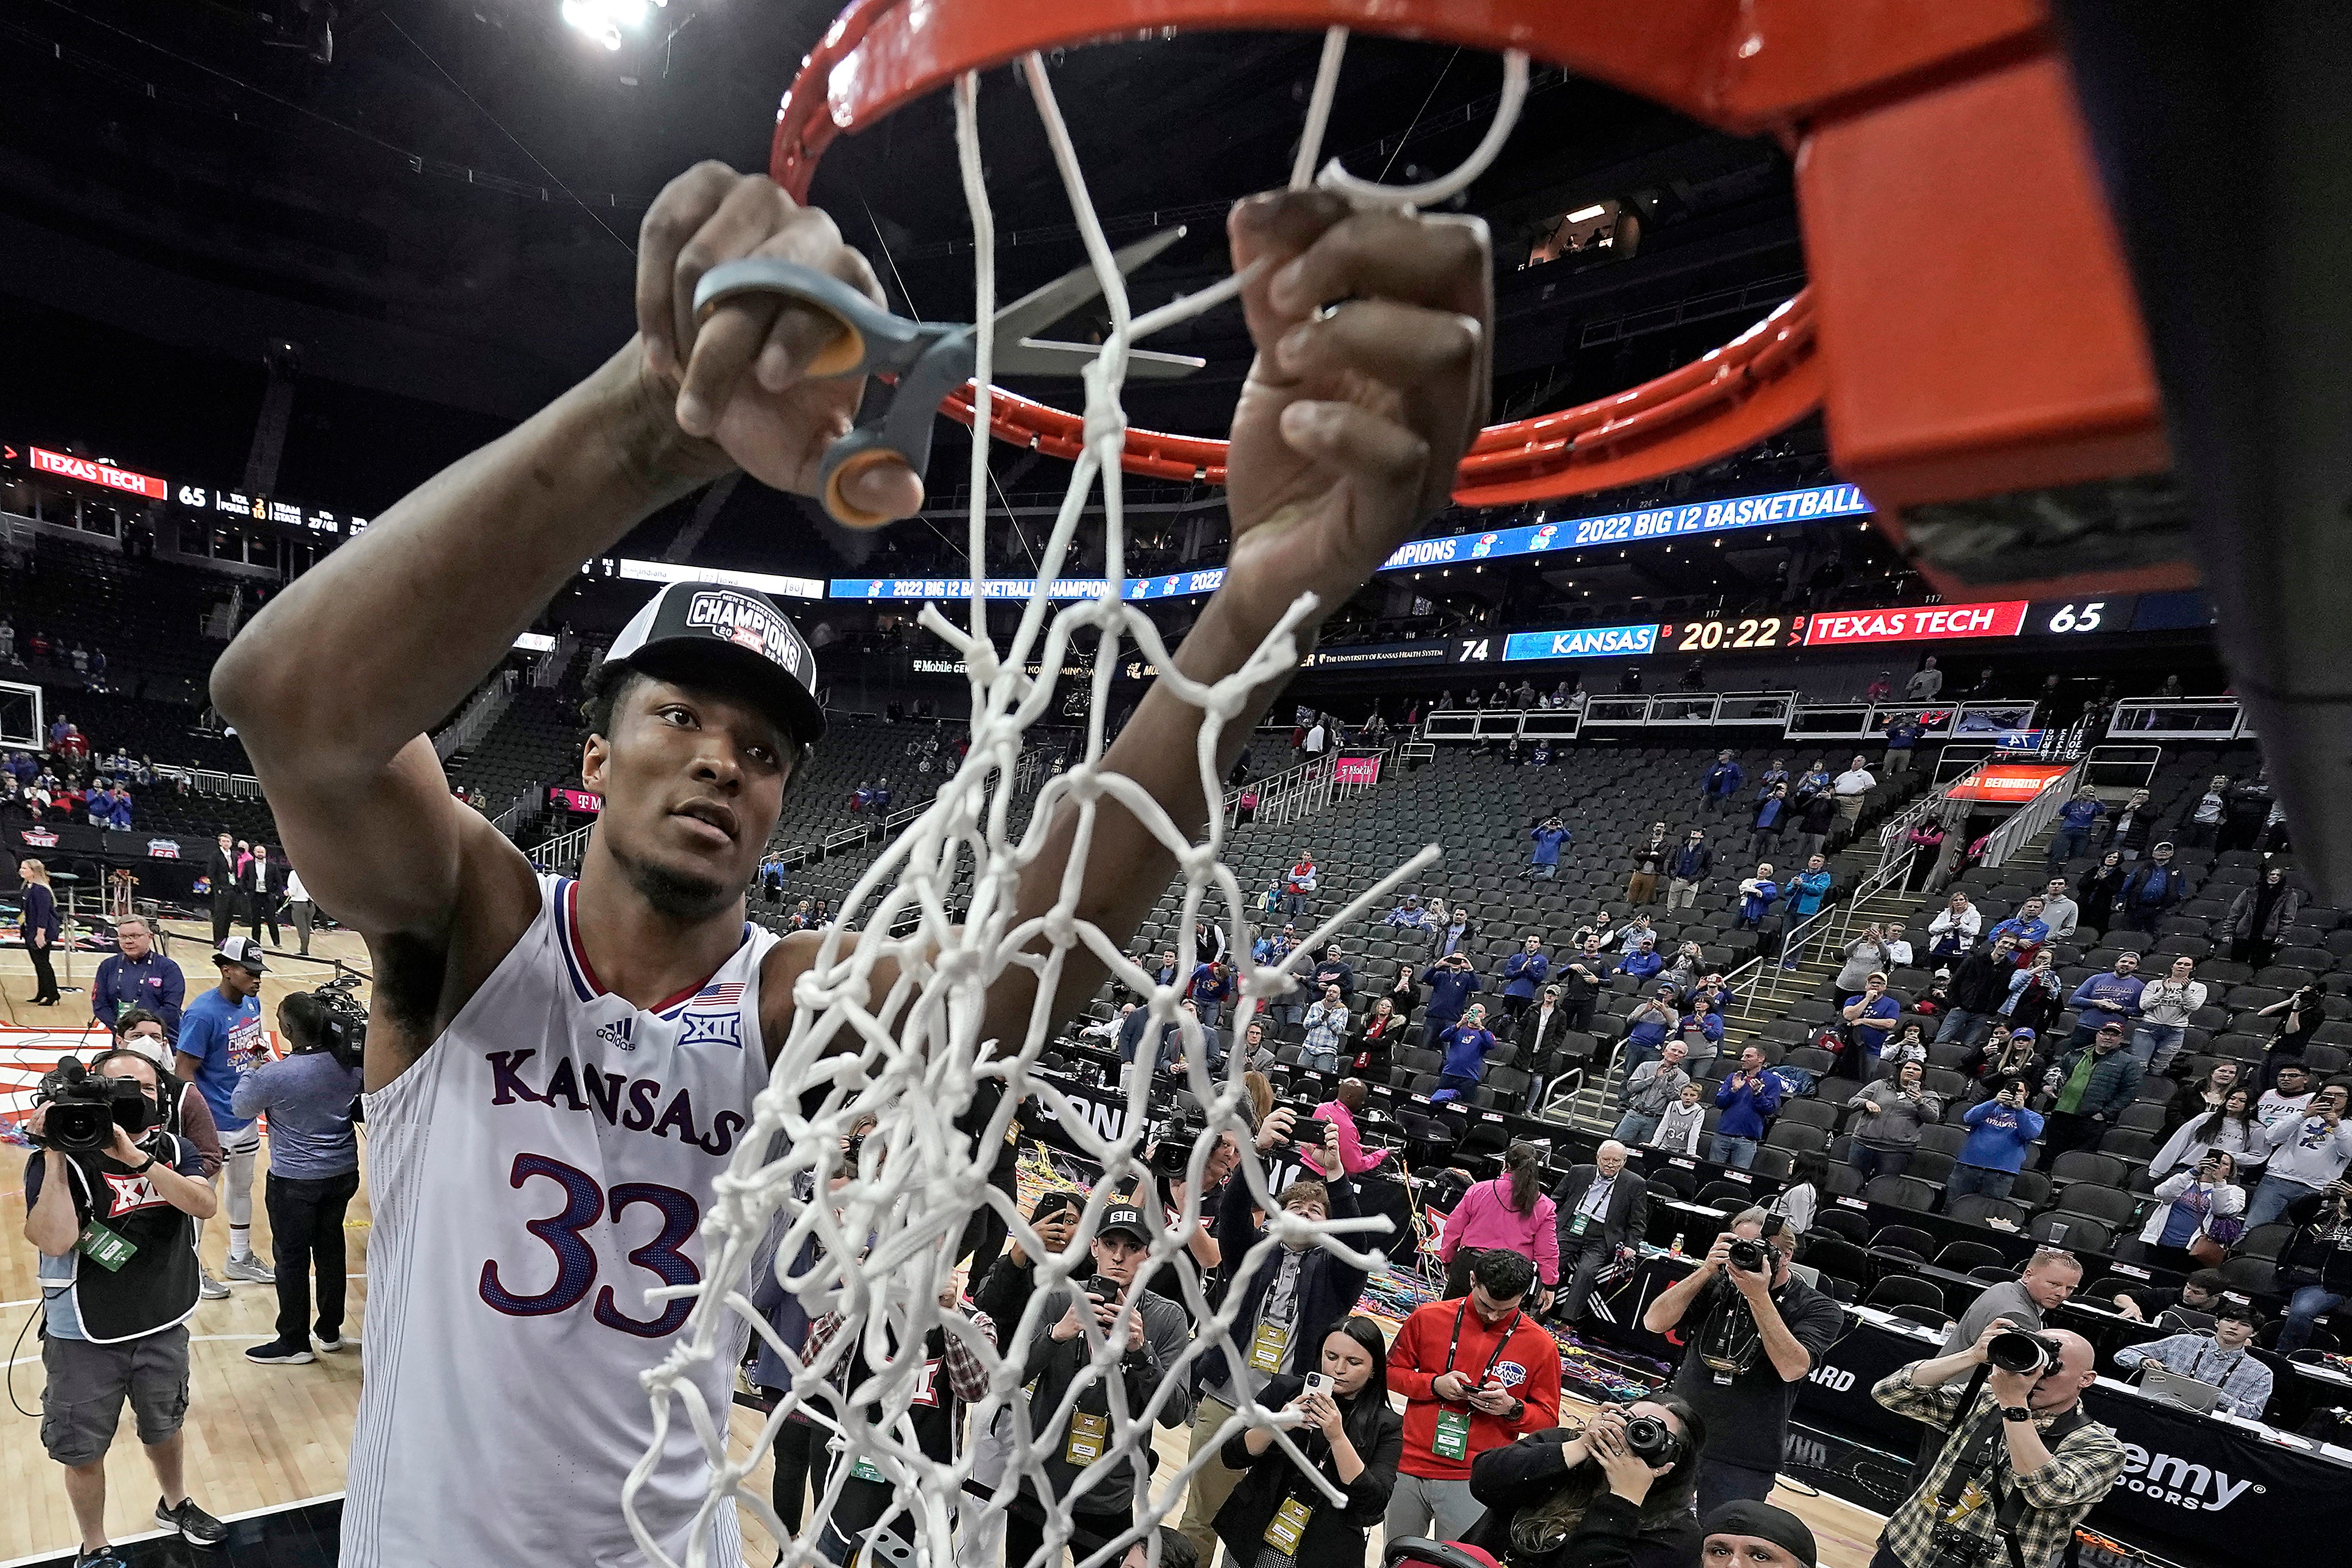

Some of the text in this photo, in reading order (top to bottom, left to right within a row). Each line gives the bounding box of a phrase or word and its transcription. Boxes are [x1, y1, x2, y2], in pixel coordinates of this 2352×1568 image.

[38, 451, 145, 492] TEXAS TECH
[179, 486, 206, 507] 65
[256, 498, 264, 509] 2
[252, 508, 266, 520] 10
[273, 502, 301, 516] TEAM
[273, 511, 302, 526] STATS
[1575, 486, 1865, 544] 2022 BIG 12 BASKETBALL
[1384, 539, 1457, 567] MPIONS
[604, 565, 612, 577] 3
[1189, 571, 1223, 591] 2022
[789, 584, 800, 592] 80
[893, 581, 924, 596] 2022
[924, 581, 947, 596] BIG
[947, 581, 959, 596] 12
[1046, 581, 1113, 597] HAMPION
[722, 594, 786, 632] MEN'S BASKETBALL
[1705, 610, 1720, 619] 117
[1792, 616, 1805, 630] B
[1817, 608, 1996, 639] TEXAS TECH
[2049, 603, 2106, 633] 65
[692, 598, 798, 673] CHAMPIONS
[1551, 628, 1651, 655] KANSAS
[1661, 624, 1673, 638] B
[1678, 617, 1781, 651] 20:22
[719, 626, 733, 637] 20
[764, 648, 777, 662] 22
[1459, 639, 1490, 662] 74
[953, 664, 971, 673] CEN
[1984, 778, 2041, 789] BENIHANA
[596, 1028, 636, 1051] adidas
[485, 1048, 746, 1156] KANSAS
[1667, 1127, 1687, 1141] 34
[478, 1152, 701, 1338] 33
[1493, 1367, 1527, 1383] KANSAS
[2122, 1443, 2253, 1511] emy
